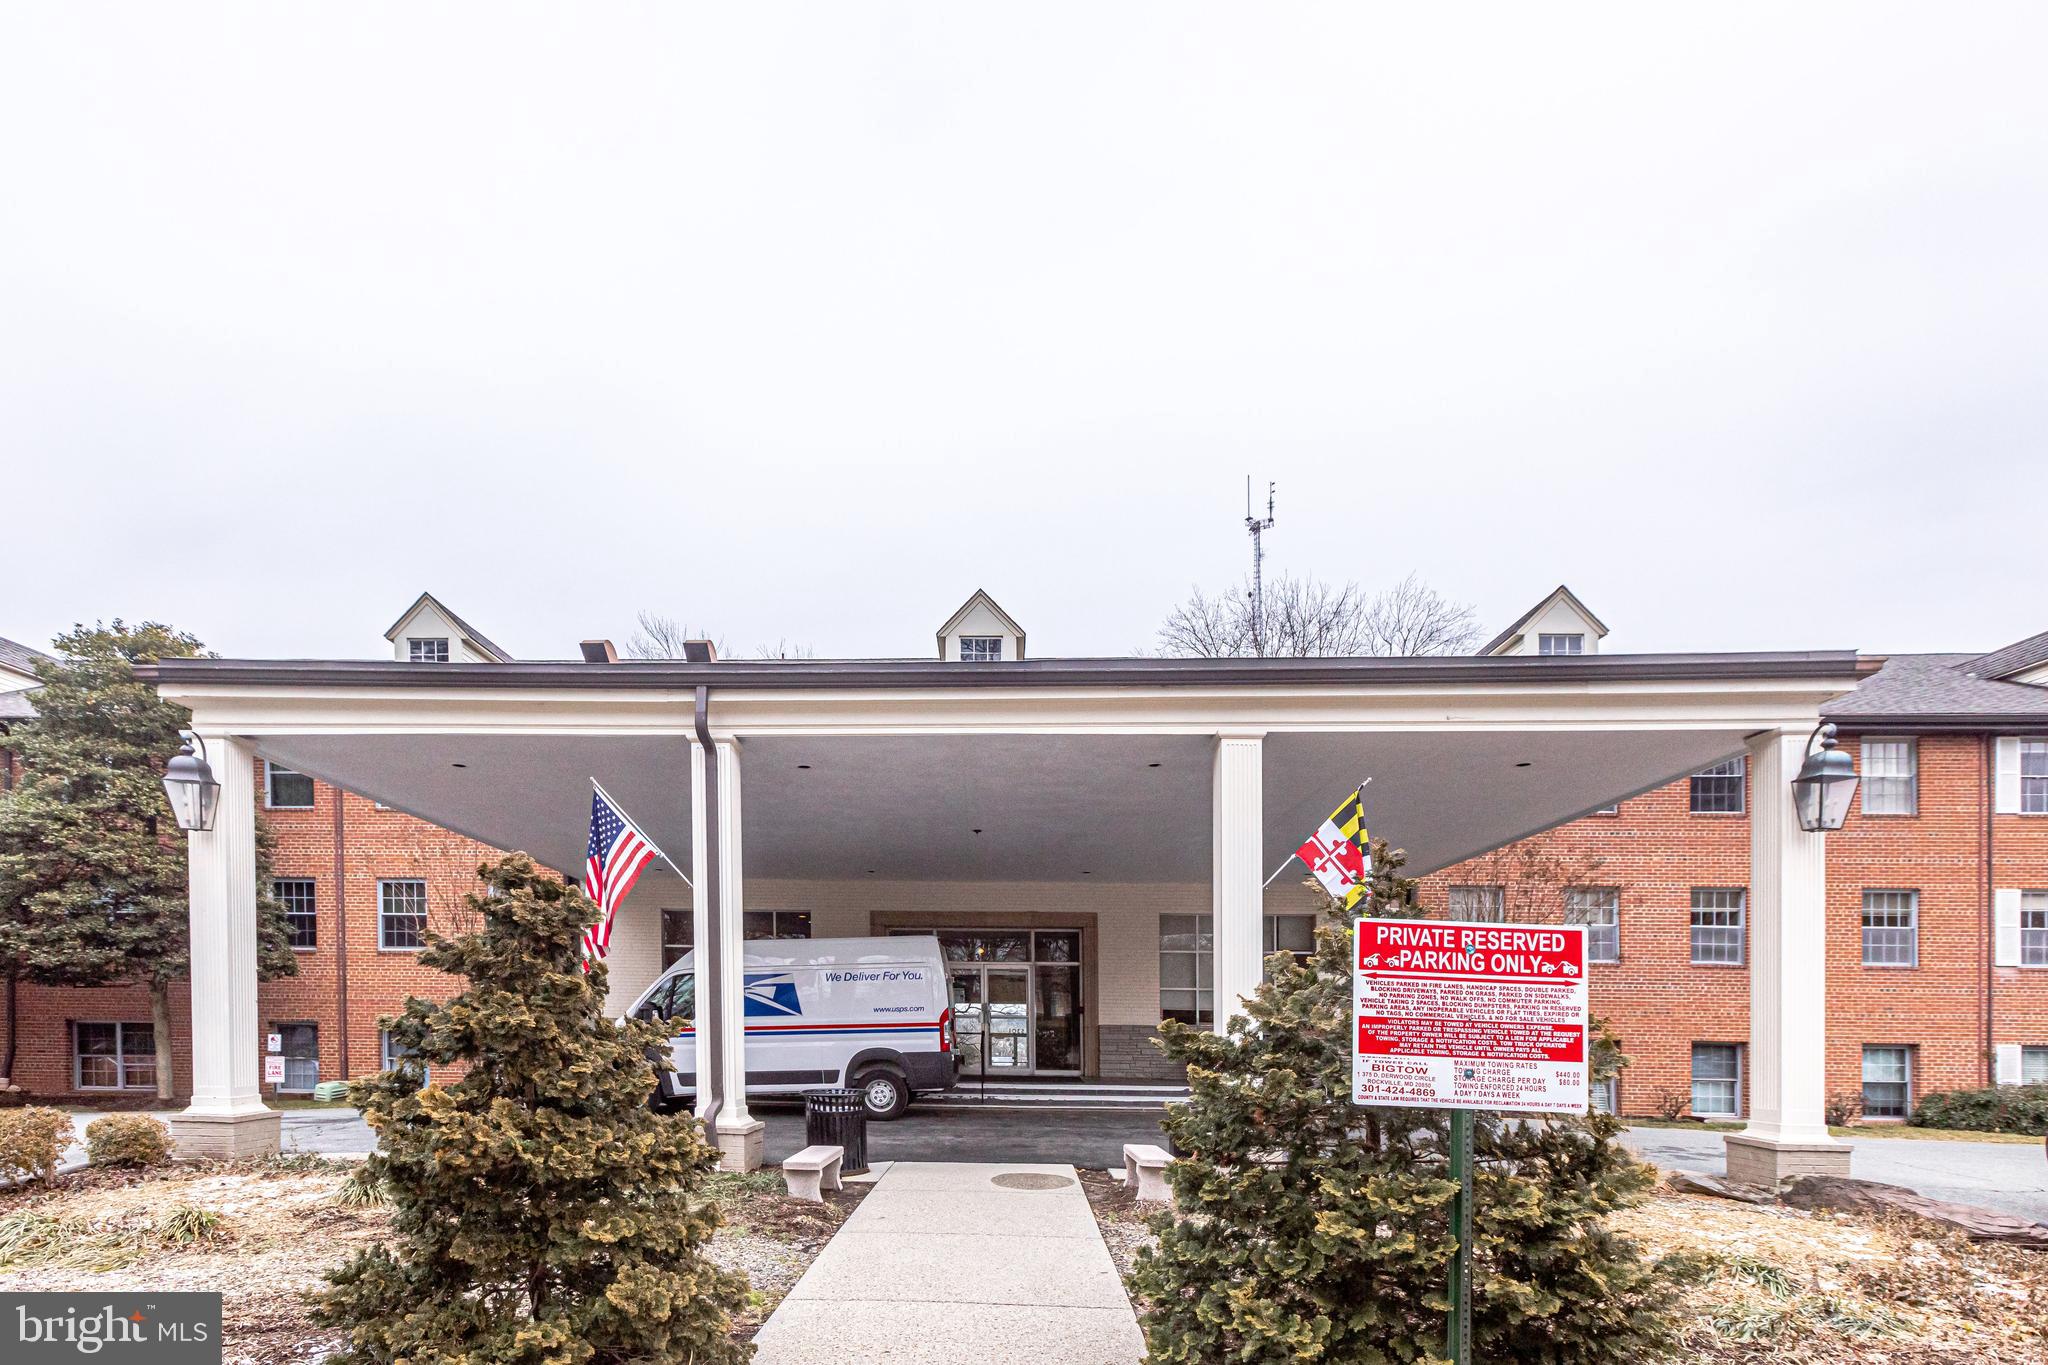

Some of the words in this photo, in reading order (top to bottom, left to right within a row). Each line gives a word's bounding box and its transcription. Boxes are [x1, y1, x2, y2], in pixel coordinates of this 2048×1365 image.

[1377, 926, 1455, 948] PRIVATE
[1462, 930, 1565, 952] RESERVED
[1400, 950, 1484, 972] PARKING
[1491, 955, 1542, 974] ONLY
[825, 972, 842, 982] We
[844, 971, 880, 982] Deliver
[883, 971, 900, 980] For
[902, 970, 923, 980] You.
[1371, 1064, 1428, 1075] BIGTOW
[1454, 1067, 1481, 1075] TONG
[1483, 1068, 1510, 1076] CHARGE
[1381, 1073, 1413, 1081] DERWOOD
[1488, 1076, 1515, 1084] CHARGE
[1556, 1071, 1580, 1079] $440.00
[1361, 1084, 1436, 1097] 301-424-4869
[1481, 1083, 1514, 1091] ENFORCED
